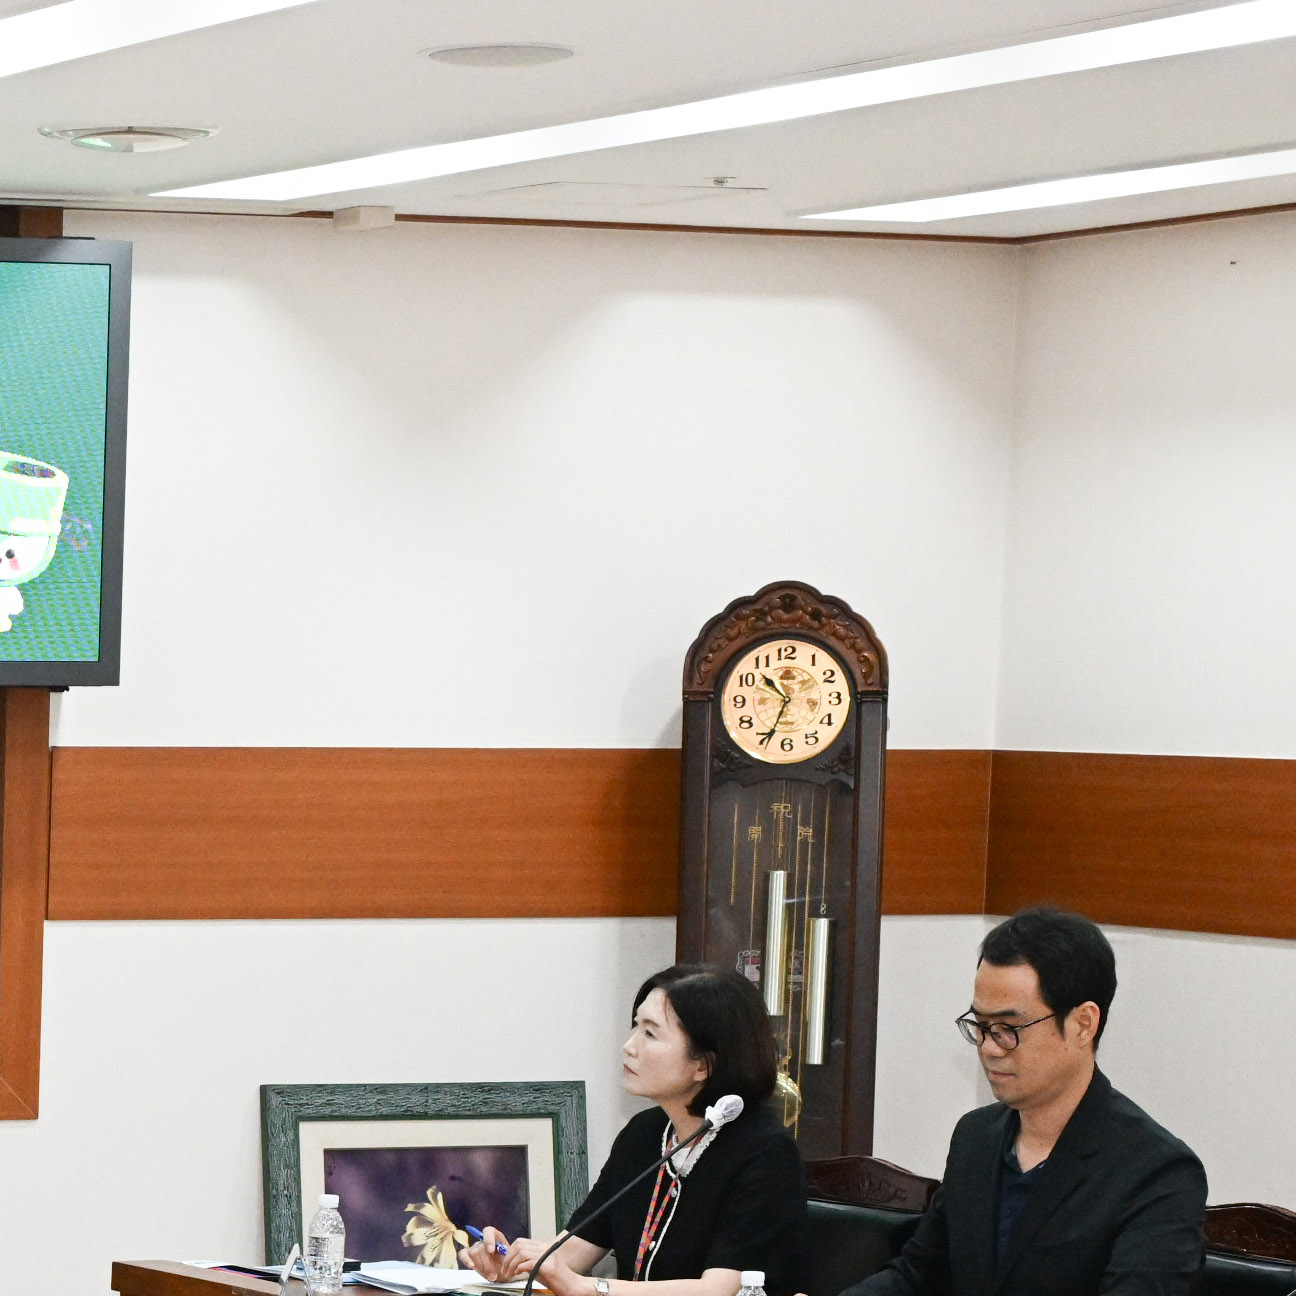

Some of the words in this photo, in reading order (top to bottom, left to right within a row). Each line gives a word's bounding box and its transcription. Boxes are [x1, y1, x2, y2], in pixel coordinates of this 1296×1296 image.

[777, 645, 797, 661] 12
[810, 653, 817, 666] 1
[754, 654, 770, 669] 11
[739, 672, 756, 687] 10
[822, 669, 836, 684] 2
[733, 694, 747, 709] 9
[828, 691, 842, 706] 3
[738, 715, 754, 730] 8
[819, 713, 835, 727] 4
[756, 732, 772, 746] 7
[780, 738, 794, 752] 6
[805, 730, 819, 746] 5
